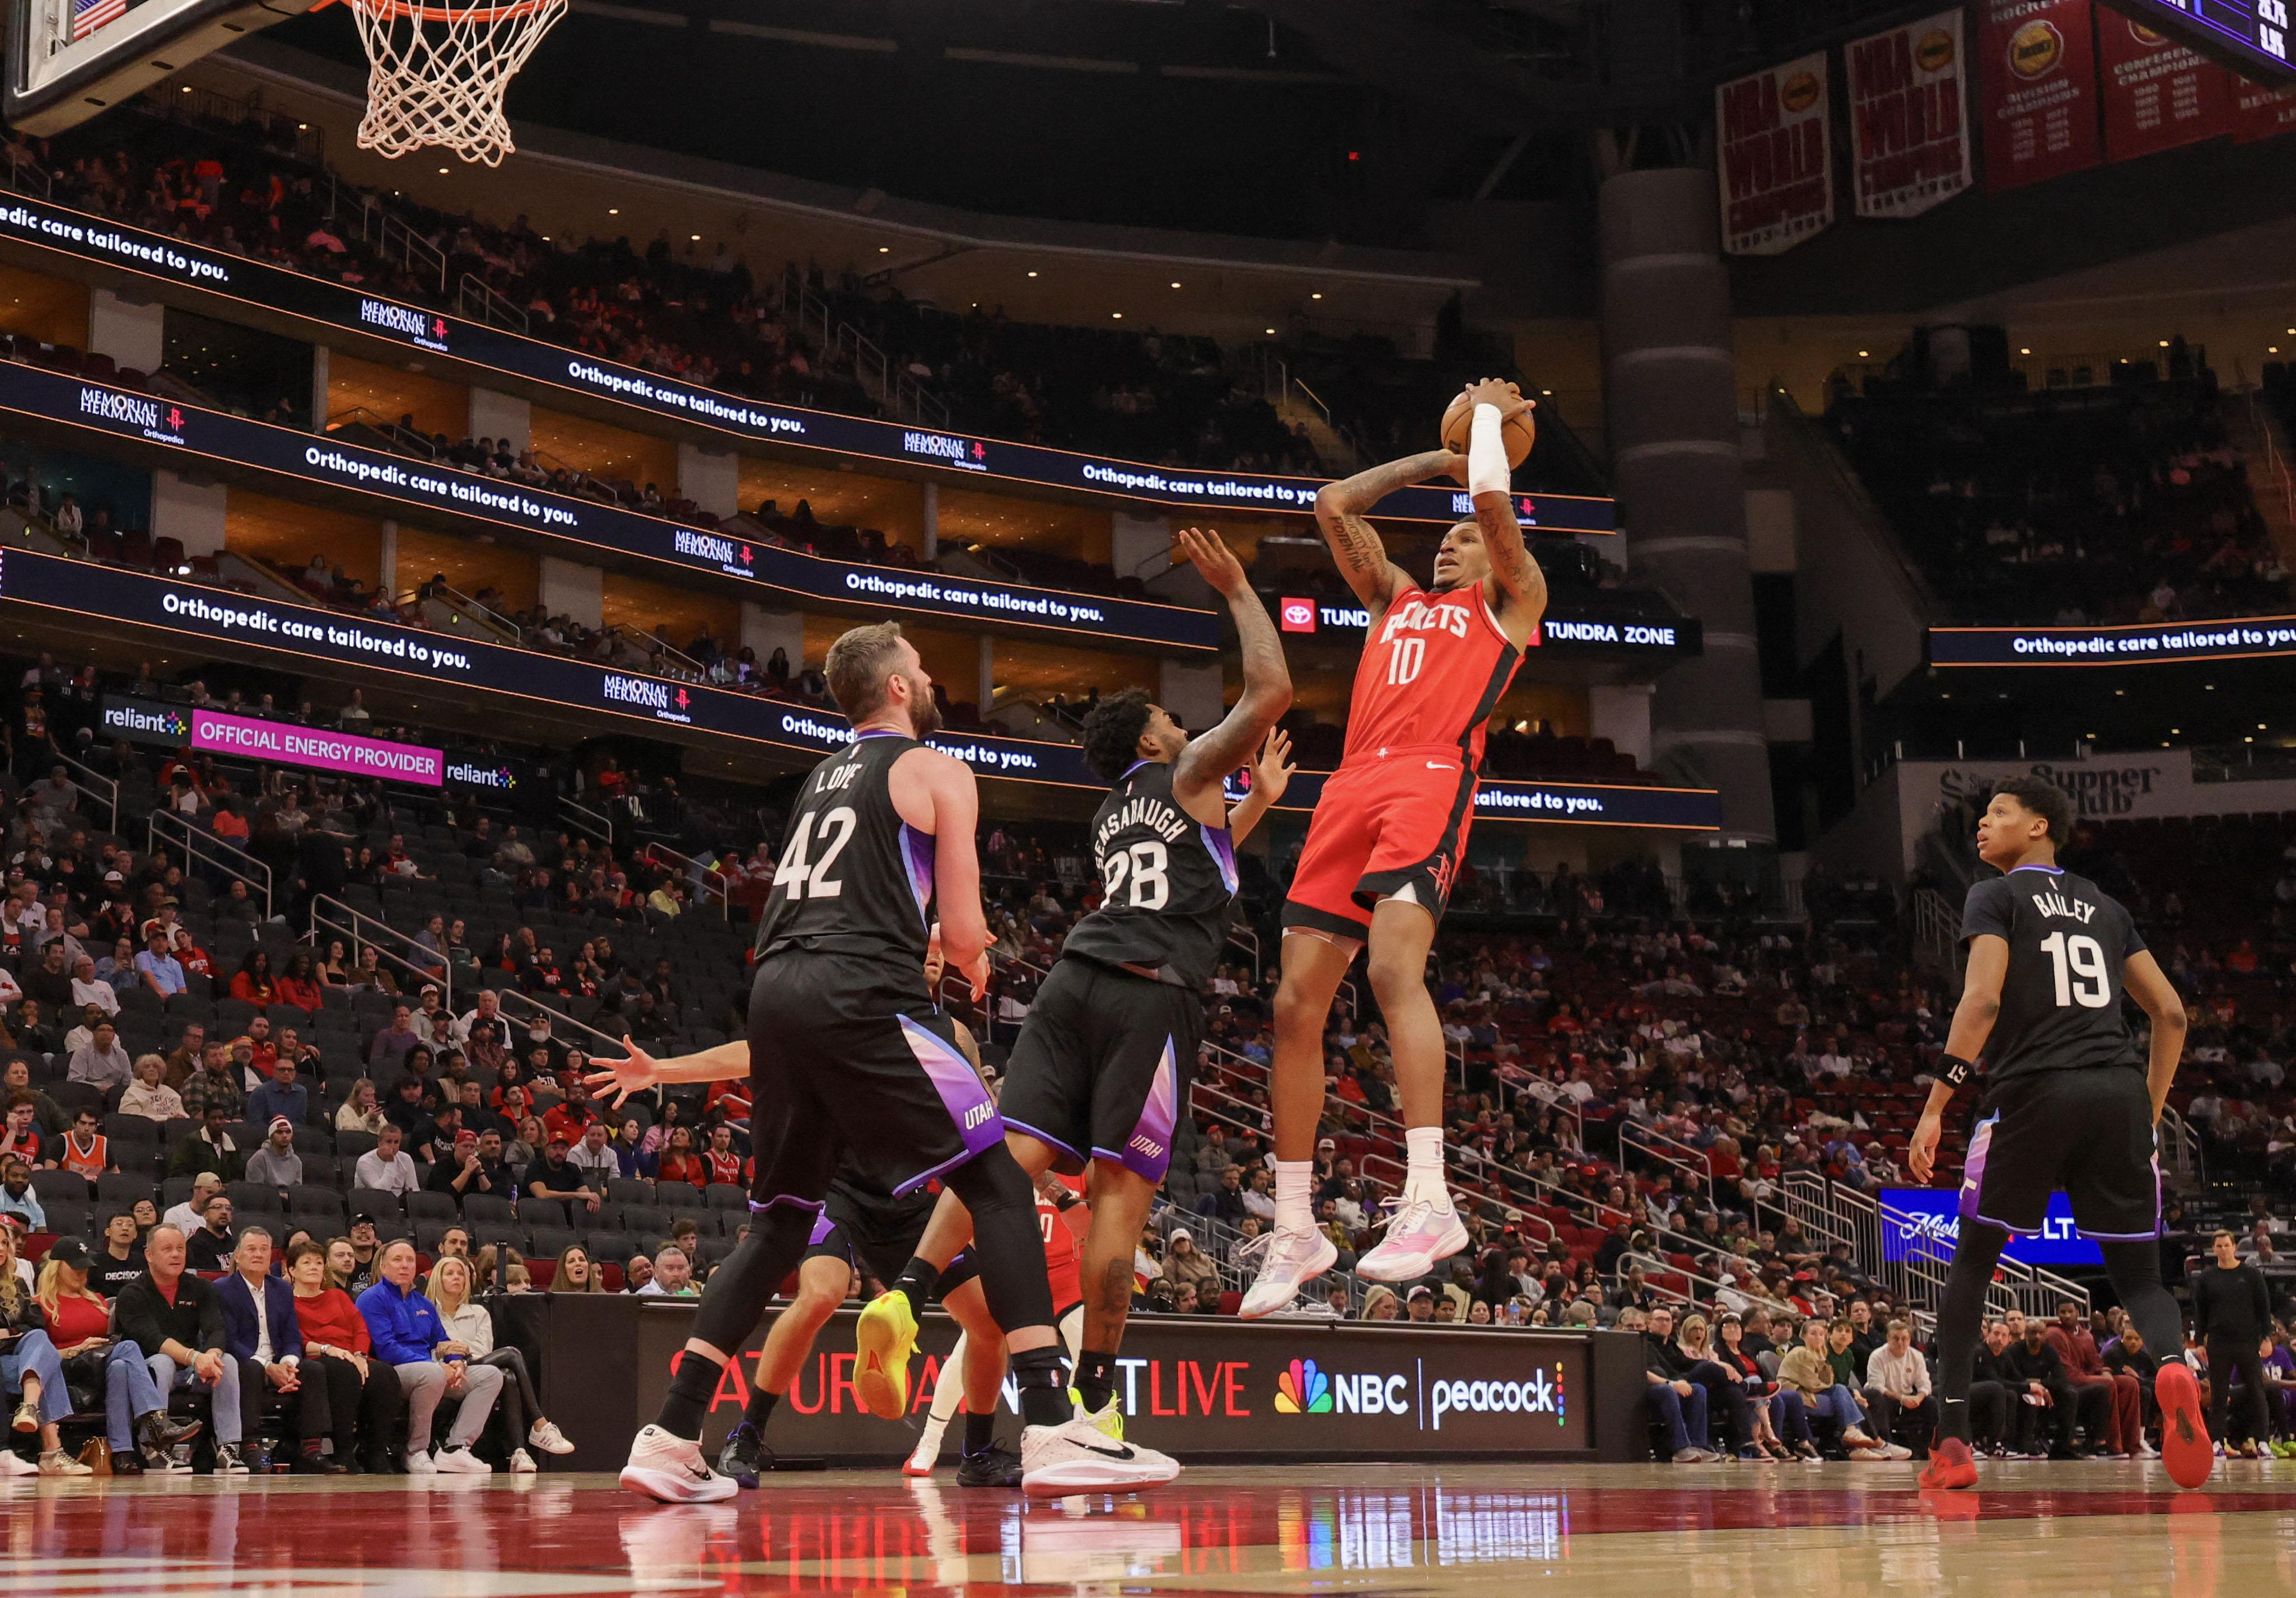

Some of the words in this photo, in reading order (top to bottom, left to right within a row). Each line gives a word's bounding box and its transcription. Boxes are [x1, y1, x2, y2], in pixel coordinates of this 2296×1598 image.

[41, 220, 82, 240] care
[87, 229, 163, 263] tailored
[167, 251, 186, 269] to
[190, 260, 228, 281] you.
[361, 309, 425, 336] HERMANN
[362, 299, 425, 326] MEMORIAL
[414, 337, 447, 351] Orthopedics
[81, 387, 157, 417] MEMORIAL
[569, 362, 652, 397] Orthopedic
[656, 390, 687, 406] care
[689, 396, 746, 423] tailored
[749, 412, 767, 426] to
[771, 418, 805, 433] you.
[81, 399, 157, 428] HERMANN
[144, 429, 184, 445] Orthopedics
[904, 432, 964, 450] MEMORIAL
[904, 440, 964, 459] HERMANN
[954, 460, 987, 471] Orthopedics
[306, 448, 406, 485] Orthopedic
[410, 476, 447, 494] care
[451, 482, 519, 512] tailored
[522, 499, 539, 516] to
[544, 507, 577, 525] you.
[1083, 464, 1167, 490] Orthopedic
[1169, 482, 1204, 493] care
[1207, 480, 1275, 498] tailored
[1276, 487, 1294, 499] to
[1297, 489, 1317, 503] yo
[675, 539, 733, 563] HERMANN
[676, 530, 733, 553] MEMORIAL
[723, 564, 753, 577] Orthopedics
[847, 574, 940, 599] Orthopedic
[944, 590, 978, 604] care
[982, 592, 1047, 614] tailored
[1049, 601, 1067, 616] to
[1070, 607, 1103, 622] you.
[163, 594, 277, 632] Orthopedic
[282, 622, 323, 641] care
[328, 627, 404, 656] tailored
[409, 642, 428, 660] to
[432, 650, 470, 669] you.
[1320, 609, 1370, 627] TUND
[1379, 600, 1471, 644] RCKETS
[1545, 622, 1618, 642] TUNDRA
[1625, 627, 1674, 644] ZONE
[2014, 638, 2114, 656] Orthopedic
[2118, 638, 2158, 651] care
[2162, 629, 2239, 648] tailored
[2242, 629, 2263, 643] to
[1387, 638, 1426, 685] 10
[604, 685, 668, 708] HERMANN
[605, 675, 668, 698] MEMORIAL
[106, 708, 165, 732] reliant
[657, 710, 690, 722] Orthopedics
[782, 716, 855, 744] Orthoped
[200, 722, 281, 750] OFFICIAL
[286, 736, 352, 760] ENERGY
[356, 747, 434, 774] PROVIDER
[979, 747, 997, 763] to
[1001, 753, 1037, 769] you.
[447, 764, 498, 786] reliant
[815, 763, 862, 795] LOVE
[1474, 791, 1542, 808] tailored
[1544, 795, 1563, 809] to
[1566, 798, 1602, 813] you.
[2078, 786, 2134, 815] lub
[1094, 797, 1188, 870] SENSABAUGH
[773, 806, 857, 900] 42
[1100, 841, 1169, 910] 28
[2032, 893, 2096, 924] BAILEY
[2040, 931, 2111, 1007] 19
[964, 1100, 994, 1130] UTAH
[1130, 1134, 1164, 1160] UTAH
[1900, 1212, 1959, 1240] Mich
[1150, 1361, 1250, 1417] LIVE
[1336, 1373, 1409, 1415] NBC
[1432, 1368, 1554, 1431] peacock
